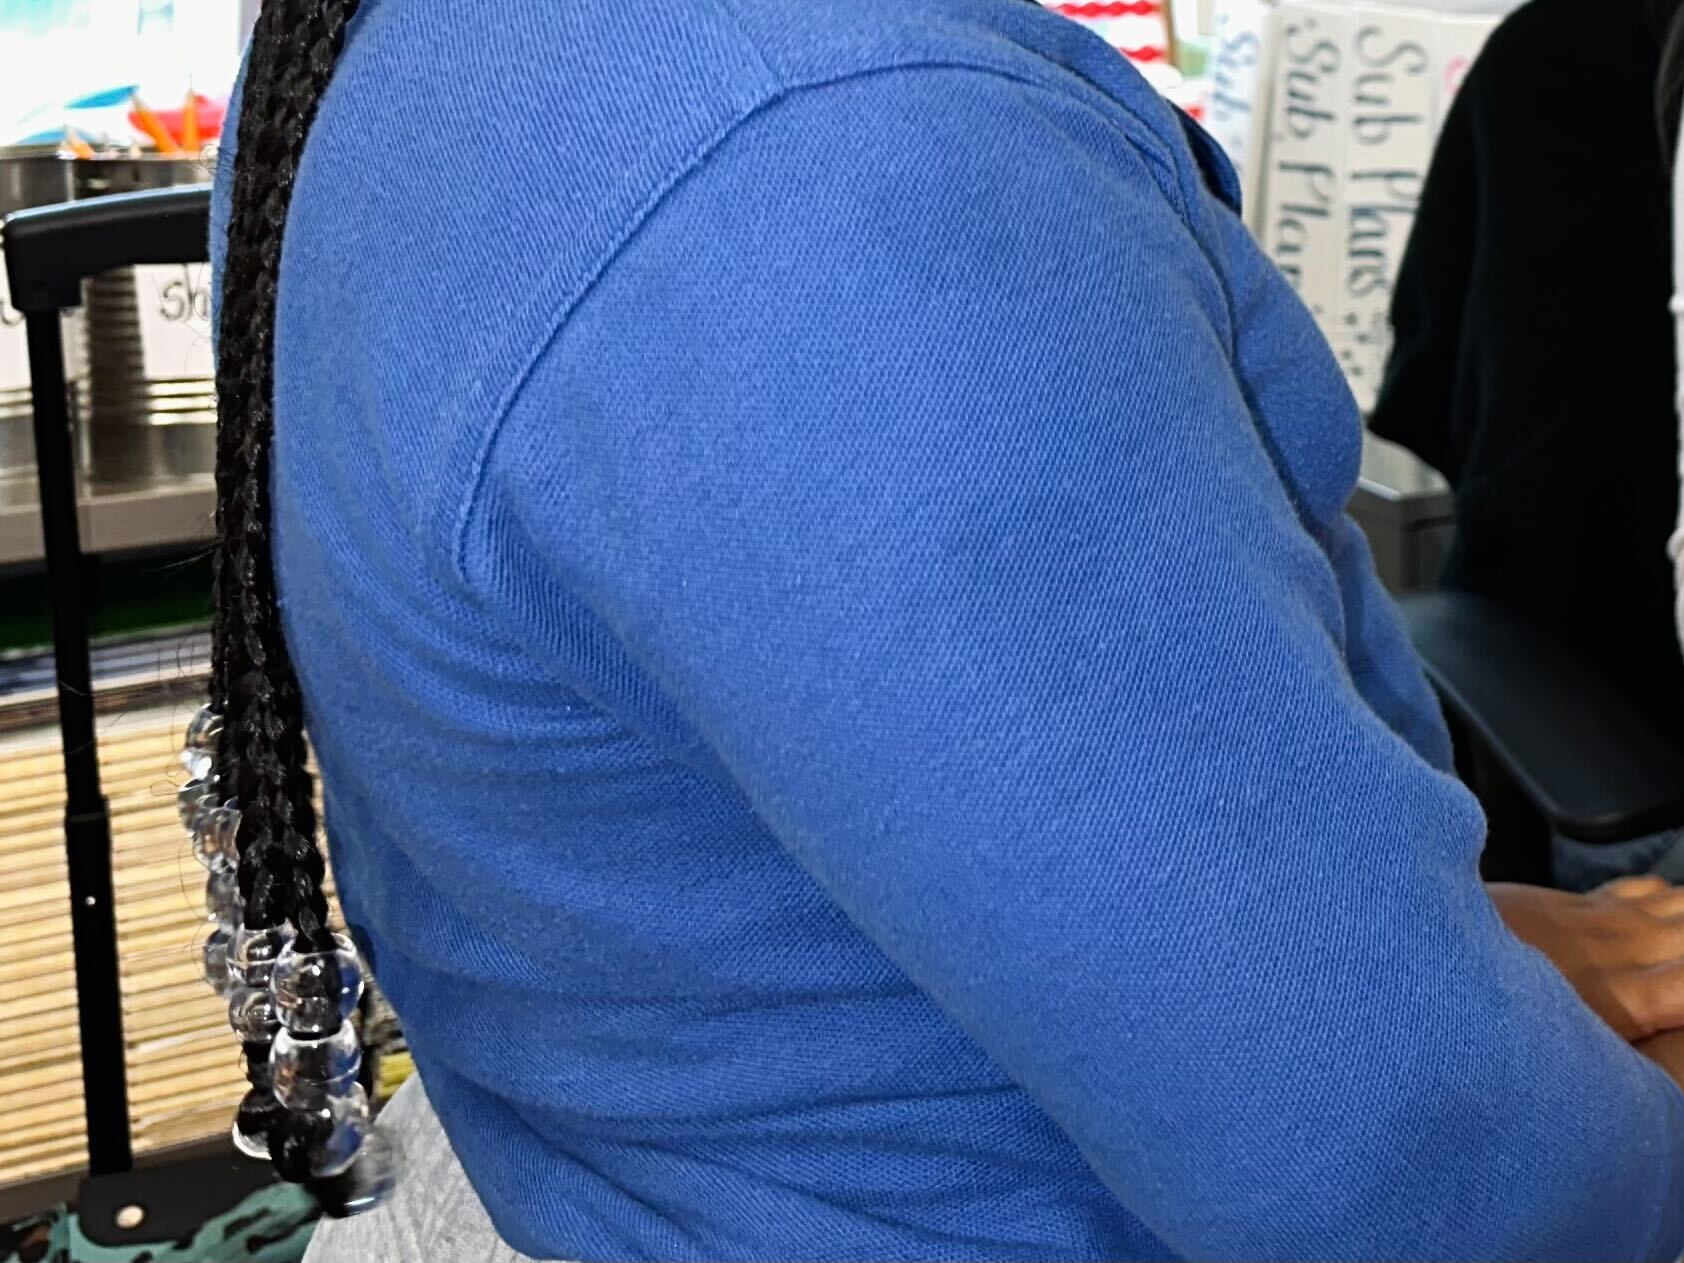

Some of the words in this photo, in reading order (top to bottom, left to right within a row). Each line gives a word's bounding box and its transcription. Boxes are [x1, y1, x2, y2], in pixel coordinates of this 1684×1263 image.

[1284, 25, 1342, 140] Sub
[1352, 26, 1428, 146] Sub
[1345, 169, 1423, 299] Plans
